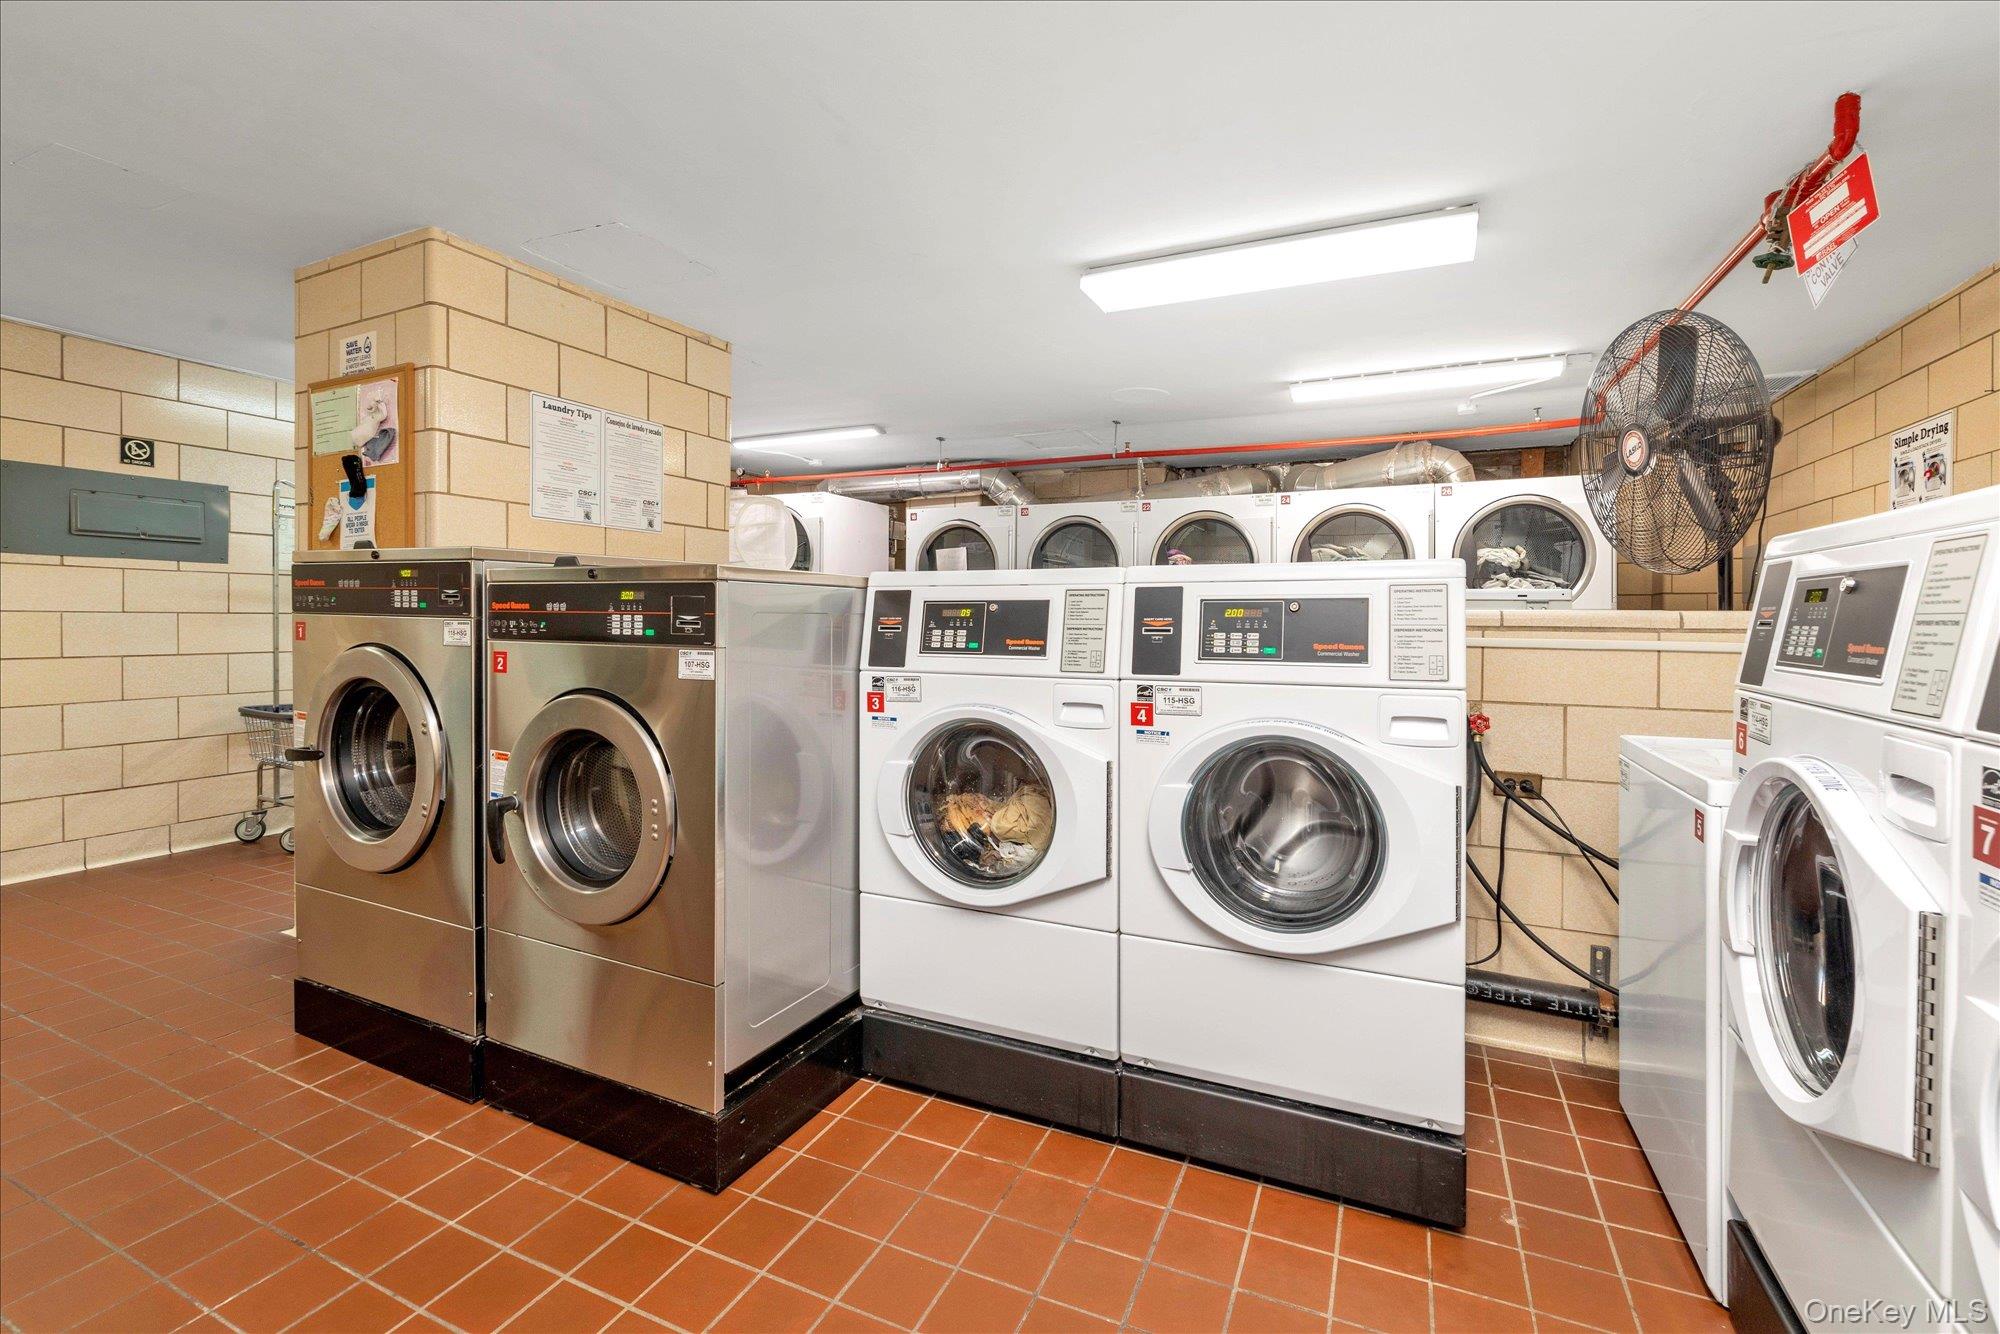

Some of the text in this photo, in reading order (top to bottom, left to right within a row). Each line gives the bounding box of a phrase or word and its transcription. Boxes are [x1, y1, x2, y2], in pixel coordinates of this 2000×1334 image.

[1820, 205, 1840, 224] OPEN
[1820, 251, 1844, 287] VALVE
[346, 340, 358, 349] SAVE
[346, 347, 362, 356] WATER
[542, 400, 592, 421] Laundry Tips
[605, 416, 626, 429] Consejos
[626, 422, 632, 430] de
[631, 423, 645, 433] lavado
[648, 427, 662, 437] secado
[1894, 422, 1949, 449] Simple Drying
[131, 459, 152, 467] SMOKING
[578, 489, 592, 497] CSC
[1441, 487, 1452, 496] 26
[642, 499, 656, 507] CSC
[1021, 508, 1029, 516] 20
[294, 579, 326, 587] Speed Queen
[491, 601, 530, 610] Speed Queen
[1005, 638, 1024, 646] Speed
[1313, 643, 1339, 651] Speed
[1847, 642, 1886, 655] Speed Queen
[497, 657, 504, 670] 2
[684, 661, 710, 669] 107-HSG
[891, 685, 917, 693] 116-HSG
[871, 697, 880, 710] 3
[1163, 696, 1195, 705] 115-HSG
[1136, 708, 1147, 723] 4
[1738, 732, 1744, 750] 6
[1696, 819, 1702, 836] 5
[1980, 824, 1996, 856] 7
